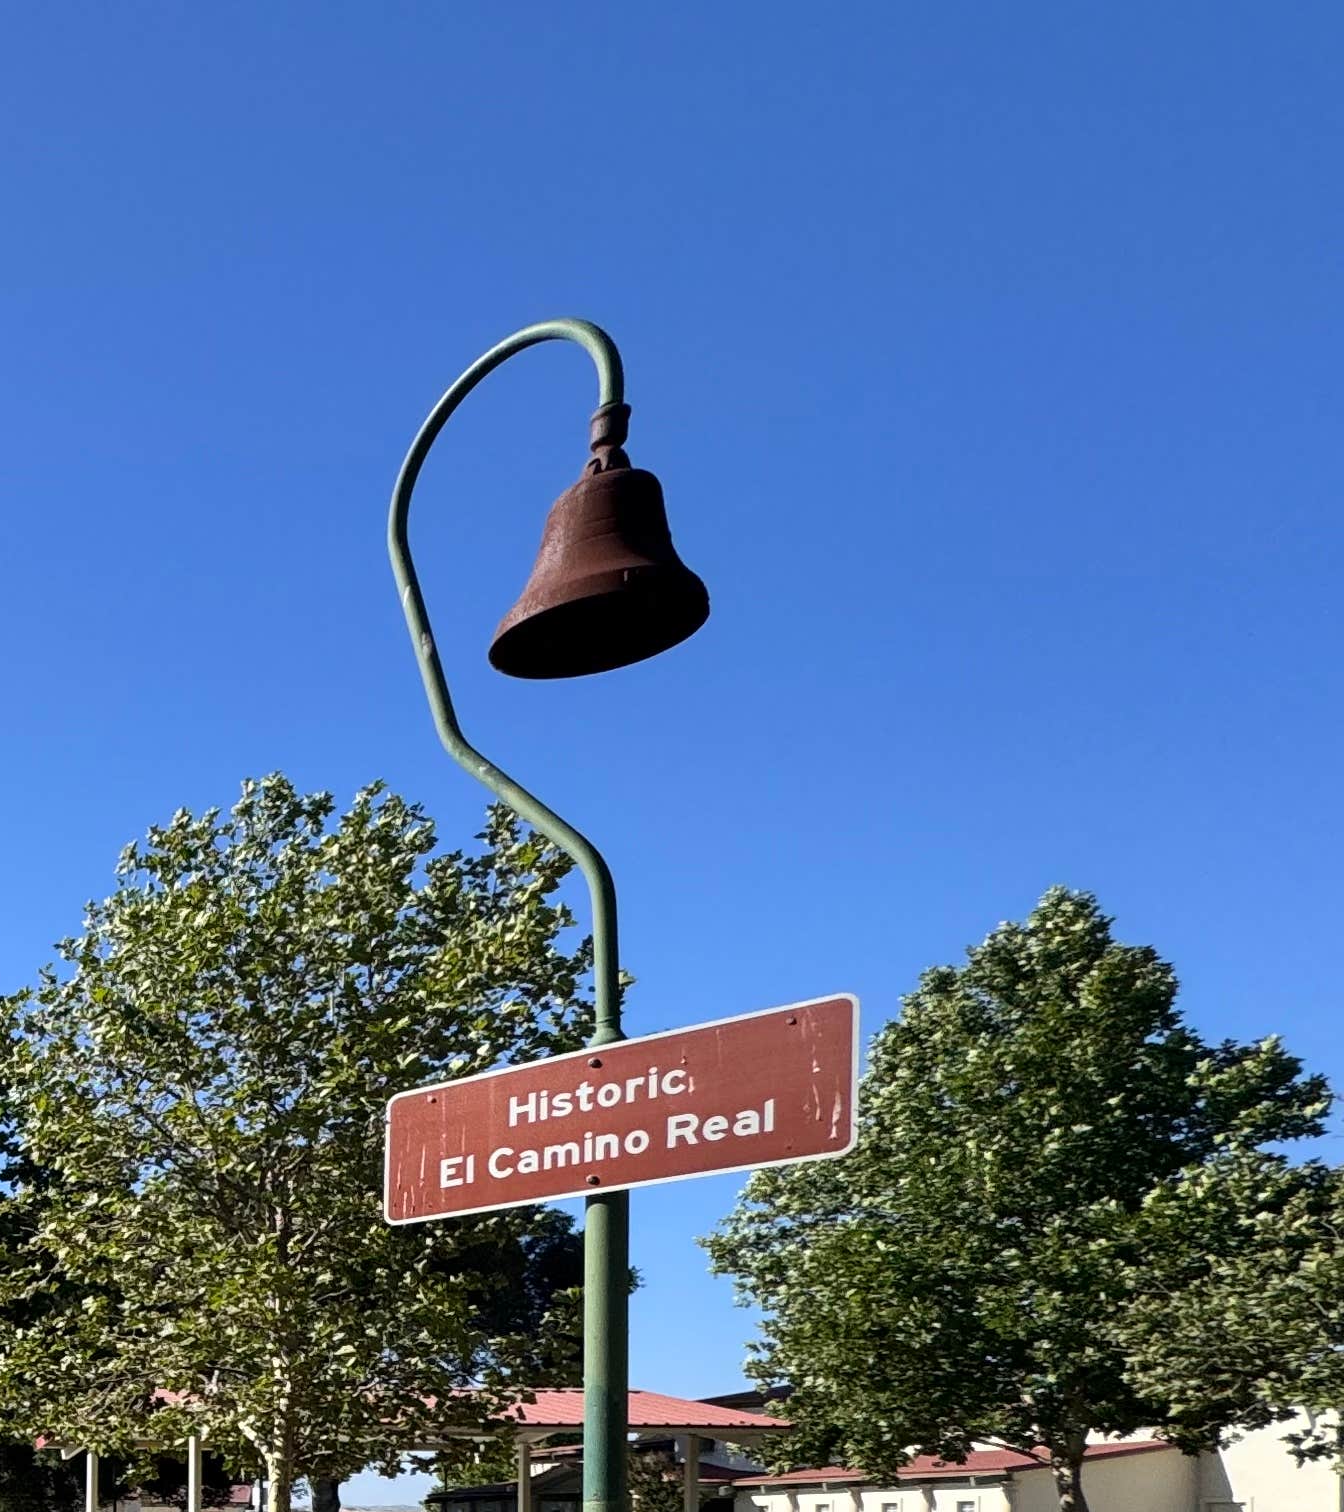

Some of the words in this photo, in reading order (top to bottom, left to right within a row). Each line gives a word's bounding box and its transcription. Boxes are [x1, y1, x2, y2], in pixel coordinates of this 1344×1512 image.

[508, 1066, 688, 1127] Historic
[439, 1155, 474, 1189] El
[487, 1130, 650, 1179] Camino
[666, 1099, 776, 1149] Real
